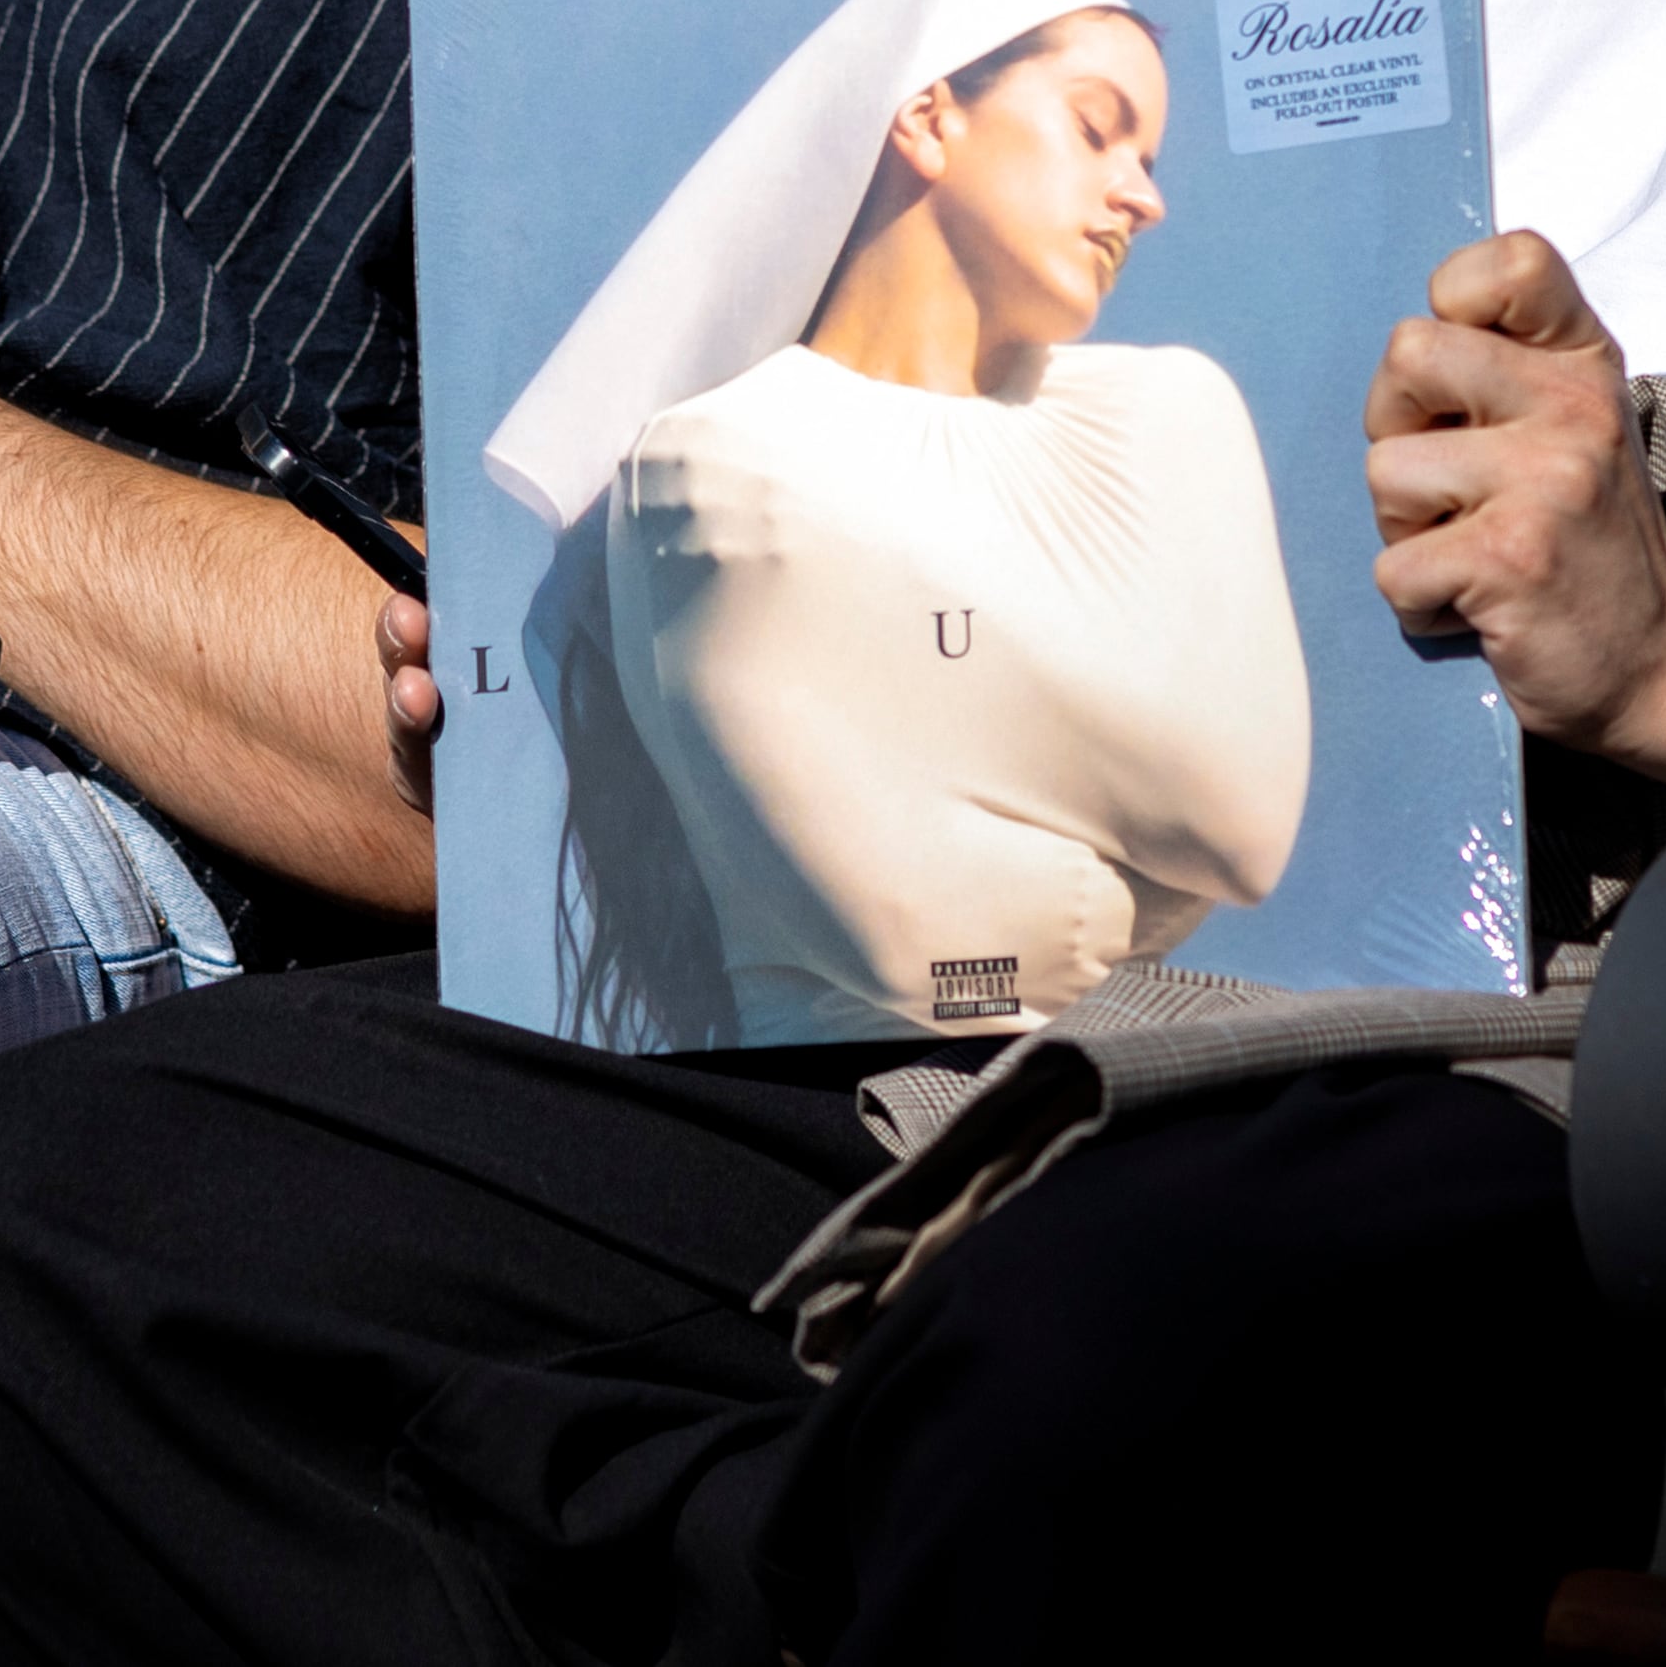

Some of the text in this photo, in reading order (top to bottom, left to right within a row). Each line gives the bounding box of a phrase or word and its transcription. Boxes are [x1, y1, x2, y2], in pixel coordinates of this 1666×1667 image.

[1244, 53, 1423, 91] ON CRYSTAL CLEAR VINYL
[1250, 72, 1421, 110] INCLUDES AN EXCLUSIVE
[1275, 98, 1344, 121] FOLD-OUT
[1347, 91, 1399, 111] POSTER
[470, 607, 976, 695] L U
[934, 960, 1015, 976] PARENTAL
[935, 976, 1016, 999] ADVISORY
[937, 999, 1017, 1018] EXPLICIT CONTENT
